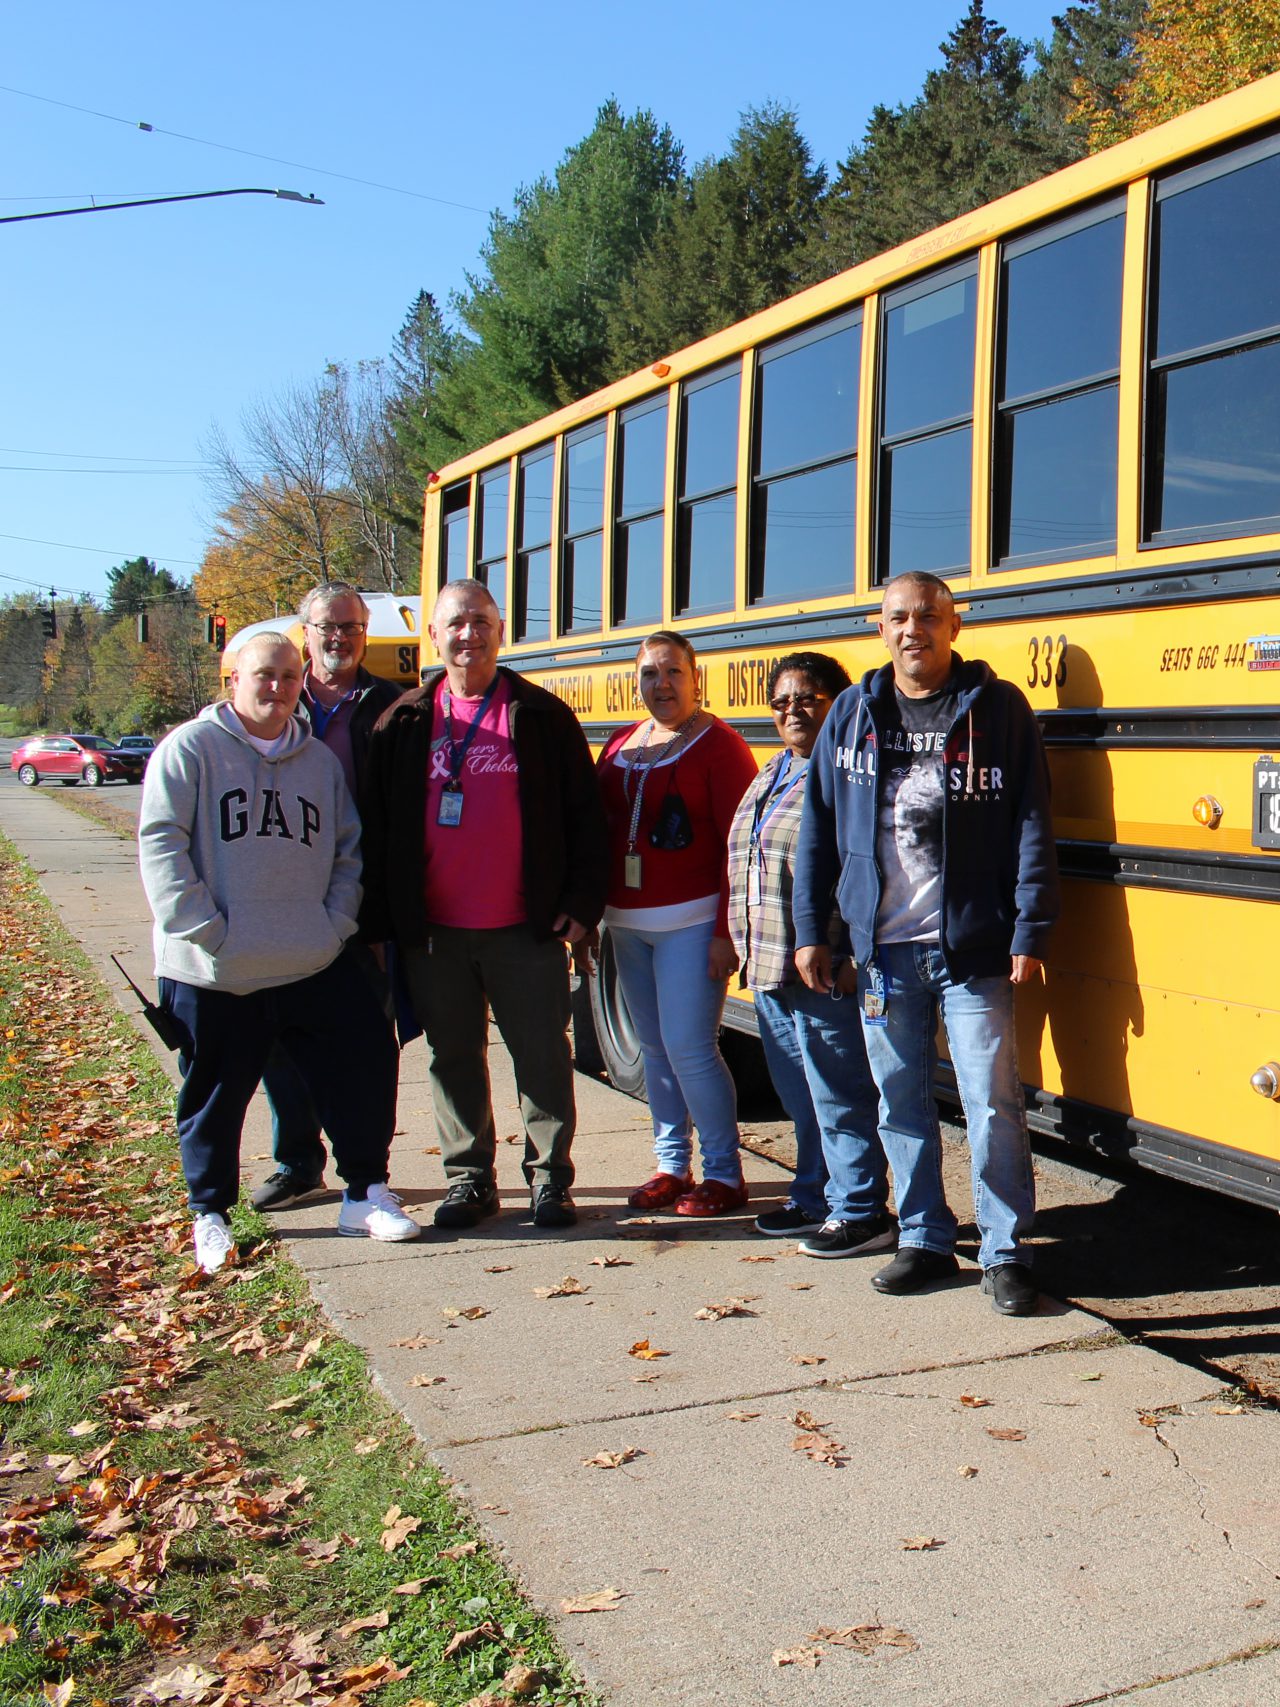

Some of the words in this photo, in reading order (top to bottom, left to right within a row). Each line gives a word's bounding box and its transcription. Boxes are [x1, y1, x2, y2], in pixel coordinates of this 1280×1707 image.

[1027, 634, 1068, 688] 333
[1160, 646, 1194, 673] SEATS
[1197, 644, 1219, 670] 66C
[1224, 642, 1247, 668] 44A
[543, 675, 592, 713] NTICELLO
[606, 671, 650, 713] CENTR
[728, 656, 781, 708] DISTRI
[836, 746, 876, 776] HLL
[950, 767, 1003, 791] SER
[218, 786, 322, 849] GAP
